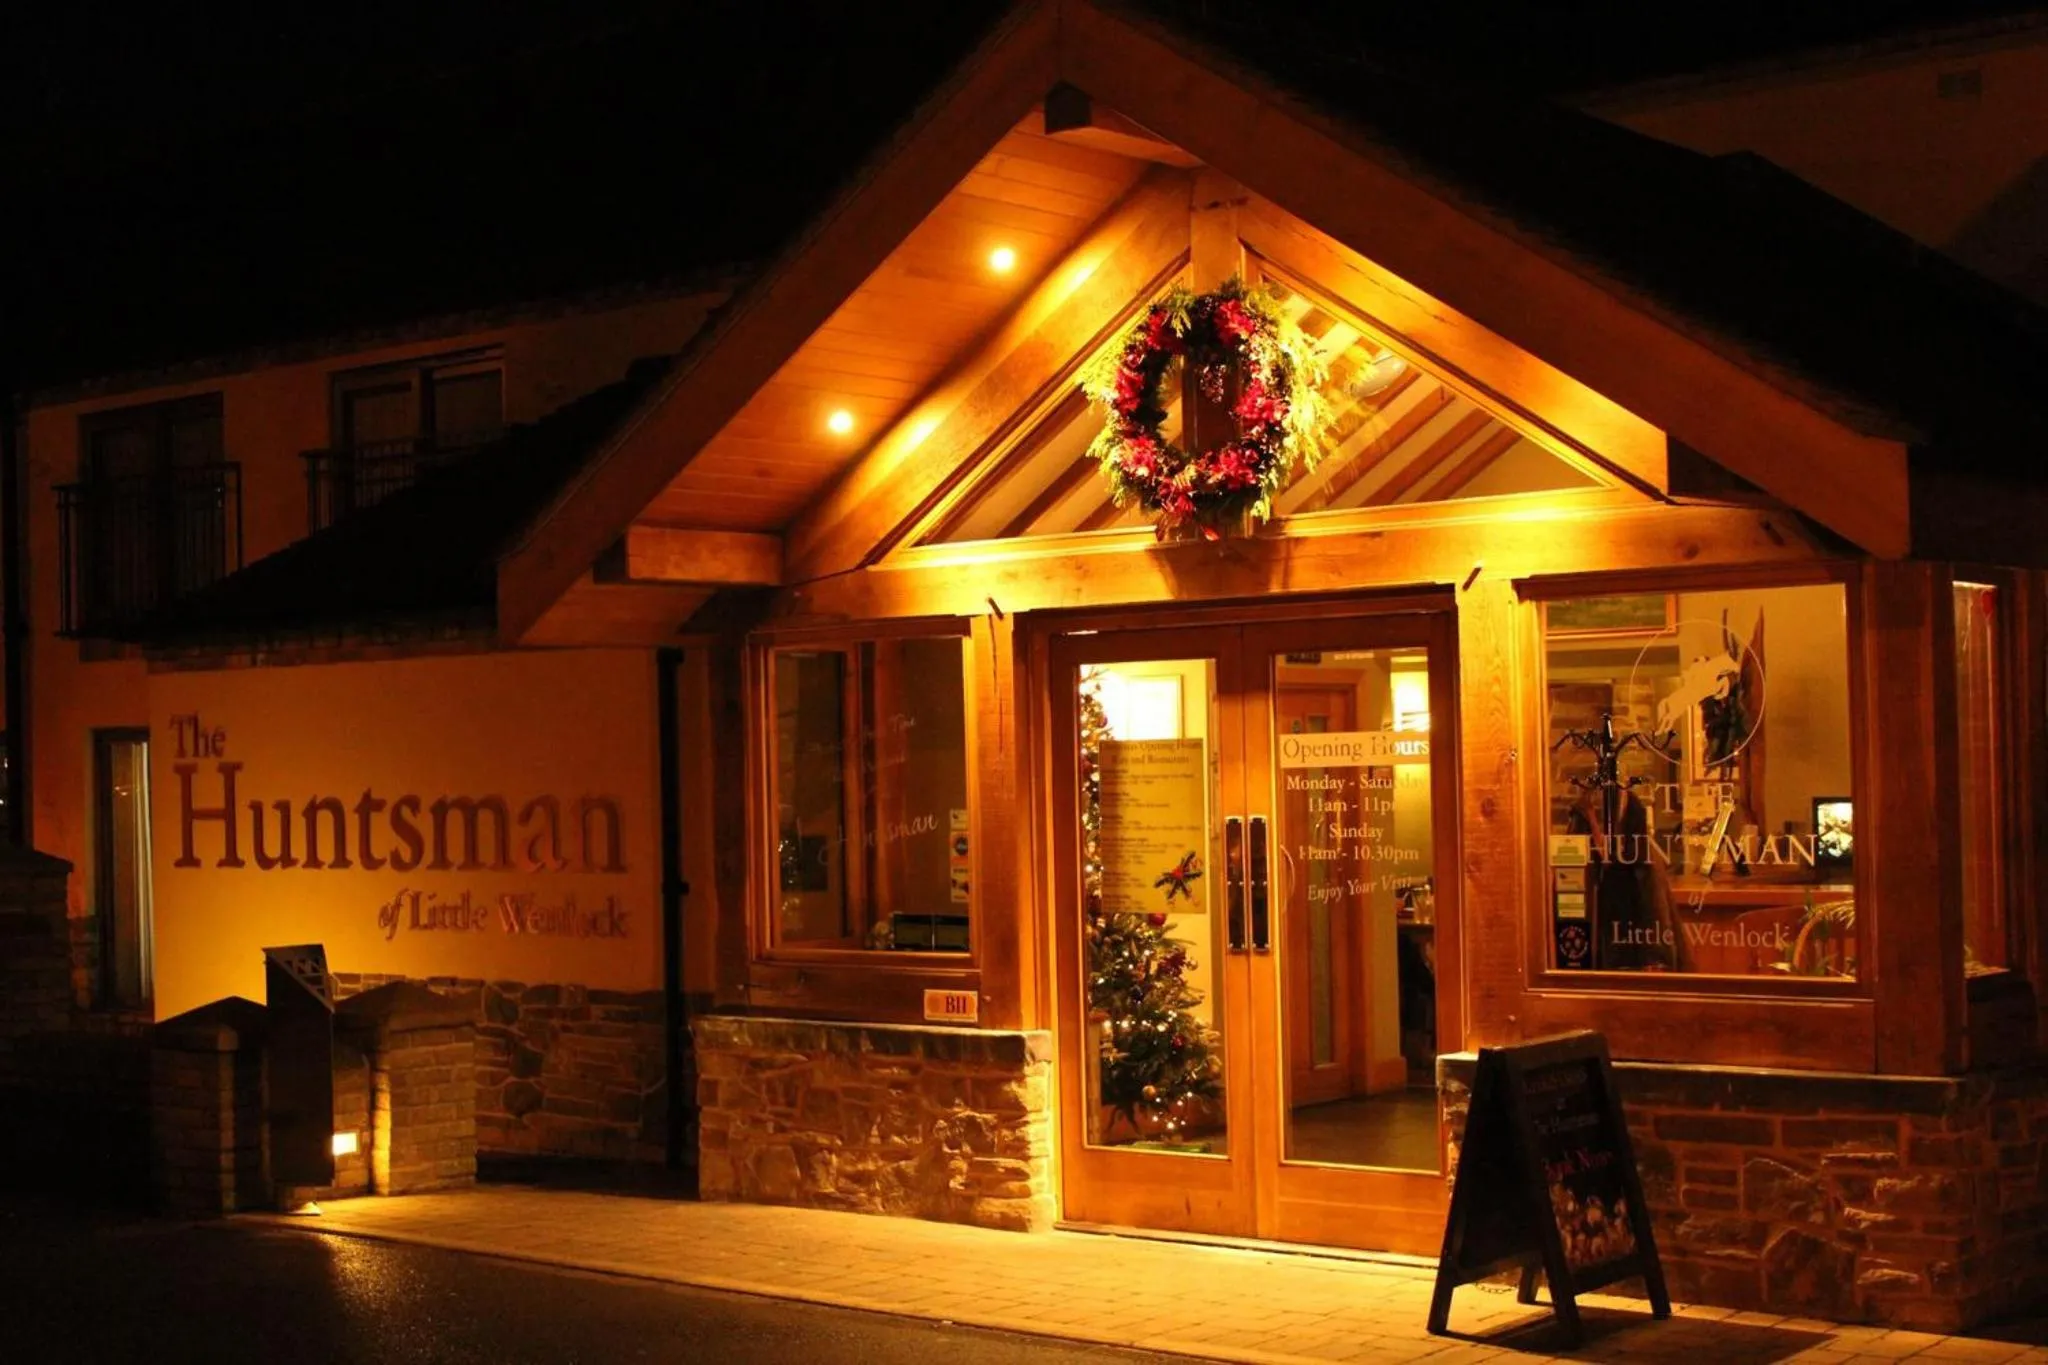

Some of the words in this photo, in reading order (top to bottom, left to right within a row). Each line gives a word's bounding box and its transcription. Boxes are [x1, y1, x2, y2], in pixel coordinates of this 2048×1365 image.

[169, 712, 226, 759] The
[1283, 737, 1363, 763] Opening
[1371, 735, 1428, 756] Hours
[1286, 774, 1345, 794] Monday
[173, 762, 628, 873] Huntsman
[1309, 797, 1347, 813] 11am
[1329, 822, 1385, 843] Sunday
[1299, 845, 1337, 861] 11am
[1353, 845, 1419, 865] 10.30pm
[1308, 882, 1344, 904] Enjoy
[1347, 879, 1377, 896] Your
[378, 888, 411, 941] of
[408, 889, 488, 932] Little
[497, 890, 629, 939] Wenlock
[1611, 920, 1675, 946] Little
[1681, 921, 1793, 950] Wenlock
